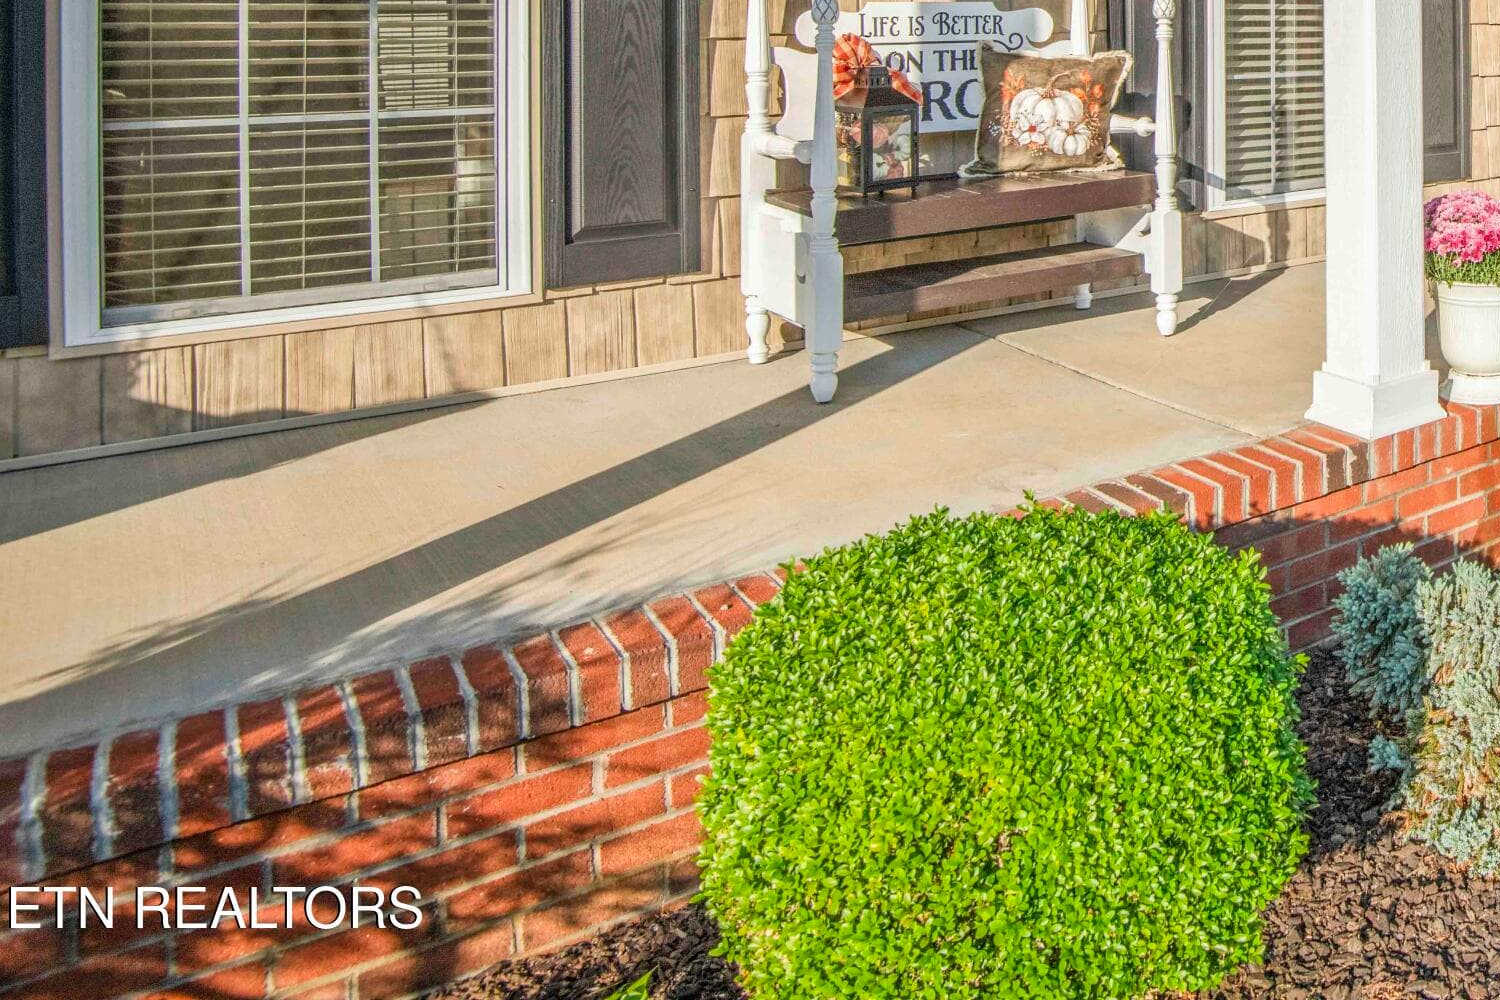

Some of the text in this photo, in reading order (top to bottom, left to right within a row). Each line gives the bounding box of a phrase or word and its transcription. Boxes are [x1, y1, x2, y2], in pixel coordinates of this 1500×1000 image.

[859, 13, 900, 37] LIFE
[908, 16, 925, 37] IS
[885, 50, 923, 74] ON
